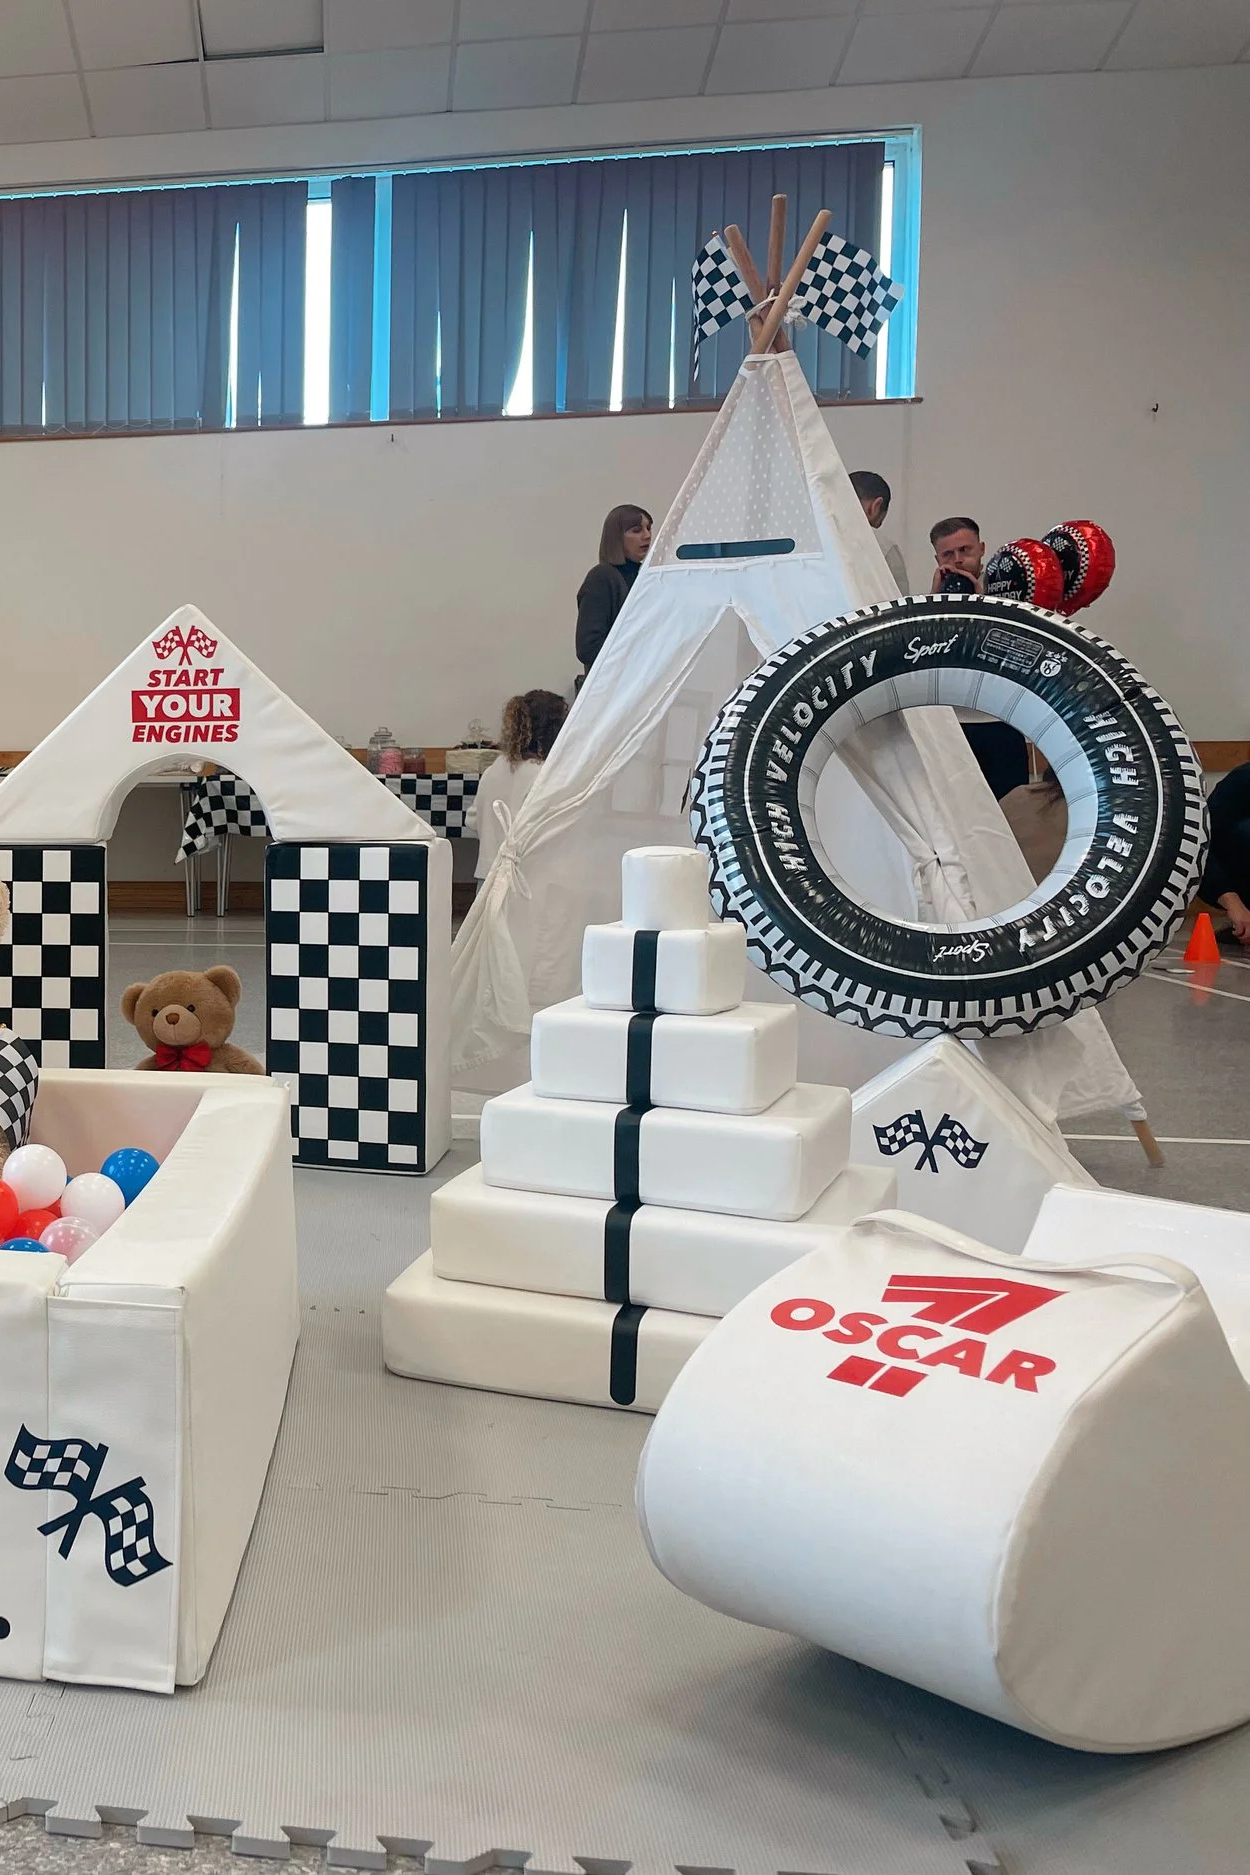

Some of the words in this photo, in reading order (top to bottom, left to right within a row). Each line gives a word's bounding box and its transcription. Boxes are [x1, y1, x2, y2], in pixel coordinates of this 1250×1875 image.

[987, 580, 1012, 593] HAPPY
[903, 633, 959, 664] Sport
[147, 668, 224, 687] START
[139, 693, 234, 719] YOUR
[766, 649, 877, 784] VELOCITY
[132, 724, 239, 743] ENGINES
[1082, 712, 1140, 786] HIGH
[766, 802, 809, 872] HIGH
[1018, 813, 1140, 953] VELOCITY
[933, 941, 990, 963] Sport
[770, 1298, 1056, 1394] OSCAR
